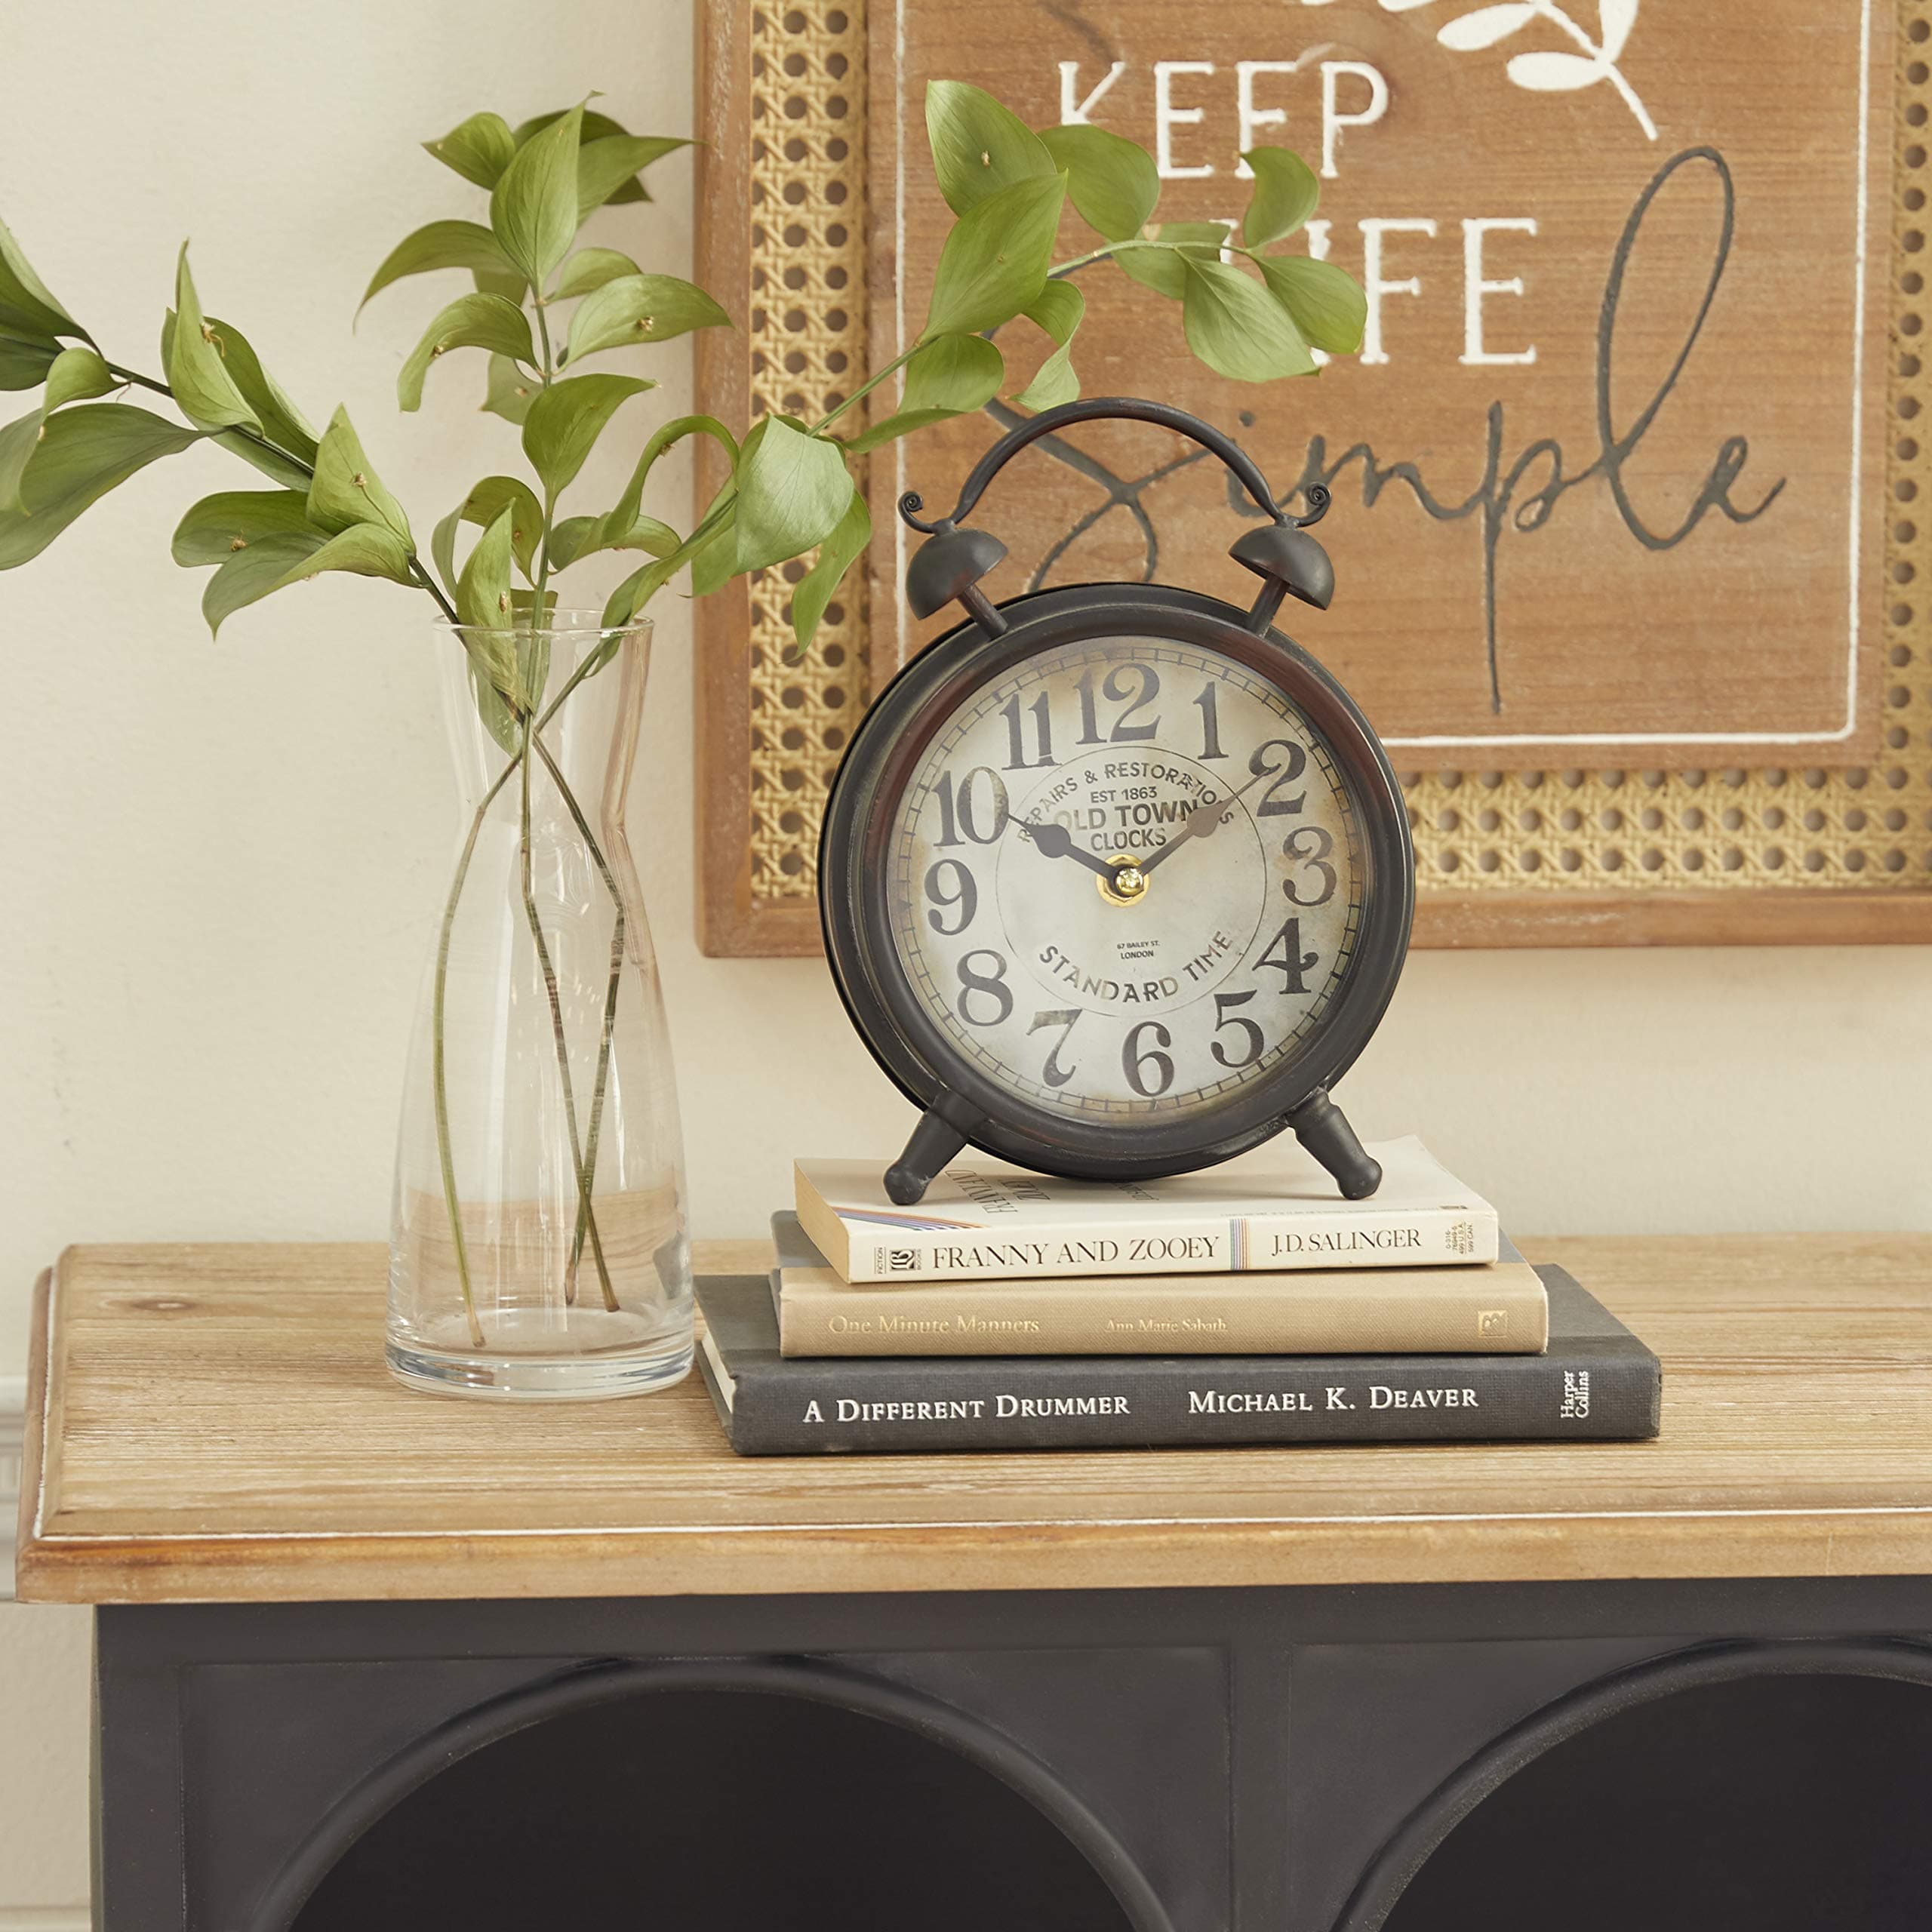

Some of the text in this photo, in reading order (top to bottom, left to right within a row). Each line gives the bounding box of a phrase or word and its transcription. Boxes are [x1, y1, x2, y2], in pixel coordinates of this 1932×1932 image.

[1210, 218, 1537, 365] FE
[999, 691, 1062, 771] 11
[1074, 663, 1162, 746] 12
[1192, 681, 1229, 760] 1
[933, 766, 1009, 847] 10
[1054, 798, 1198, 831] OLD TOWN
[1091, 786, 1158, 804] EST 1863
[1104, 762, 1234, 825] RESTORATIOS
[1247, 740, 1306, 817] 2
[1091, 828, 1167, 851] CLOCKS
[1282, 826, 1337, 906] 3
[924, 859, 977, 935] 9
[956, 949, 1014, 1026] 8
[1039, 931, 1233, 1003] STANDARD TIME
[1121, 950, 1154, 959] LONDON
[1252, 917, 1318, 995] 4
[1026, 1009, 1083, 1087] 7
[1121, 1020, 1174, 1097] 6
[1211, 989, 1265, 1068] 5
[932, 1236, 1220, 1269] FRANNY AND ZOOEY
[829, 1315, 1040, 1333] One Minute Manners
[1105, 1318, 1227, 1331] Ann Marie Sabath
[802, 1394, 1131, 1423] A DIFFERENT DRUMMER
[1188, 1385, 1479, 1413] MICHAEL K. DEAVER
[1560, 1371, 1578, 1418] Harper
[1574, 1371, 1589, 1418] Collins
